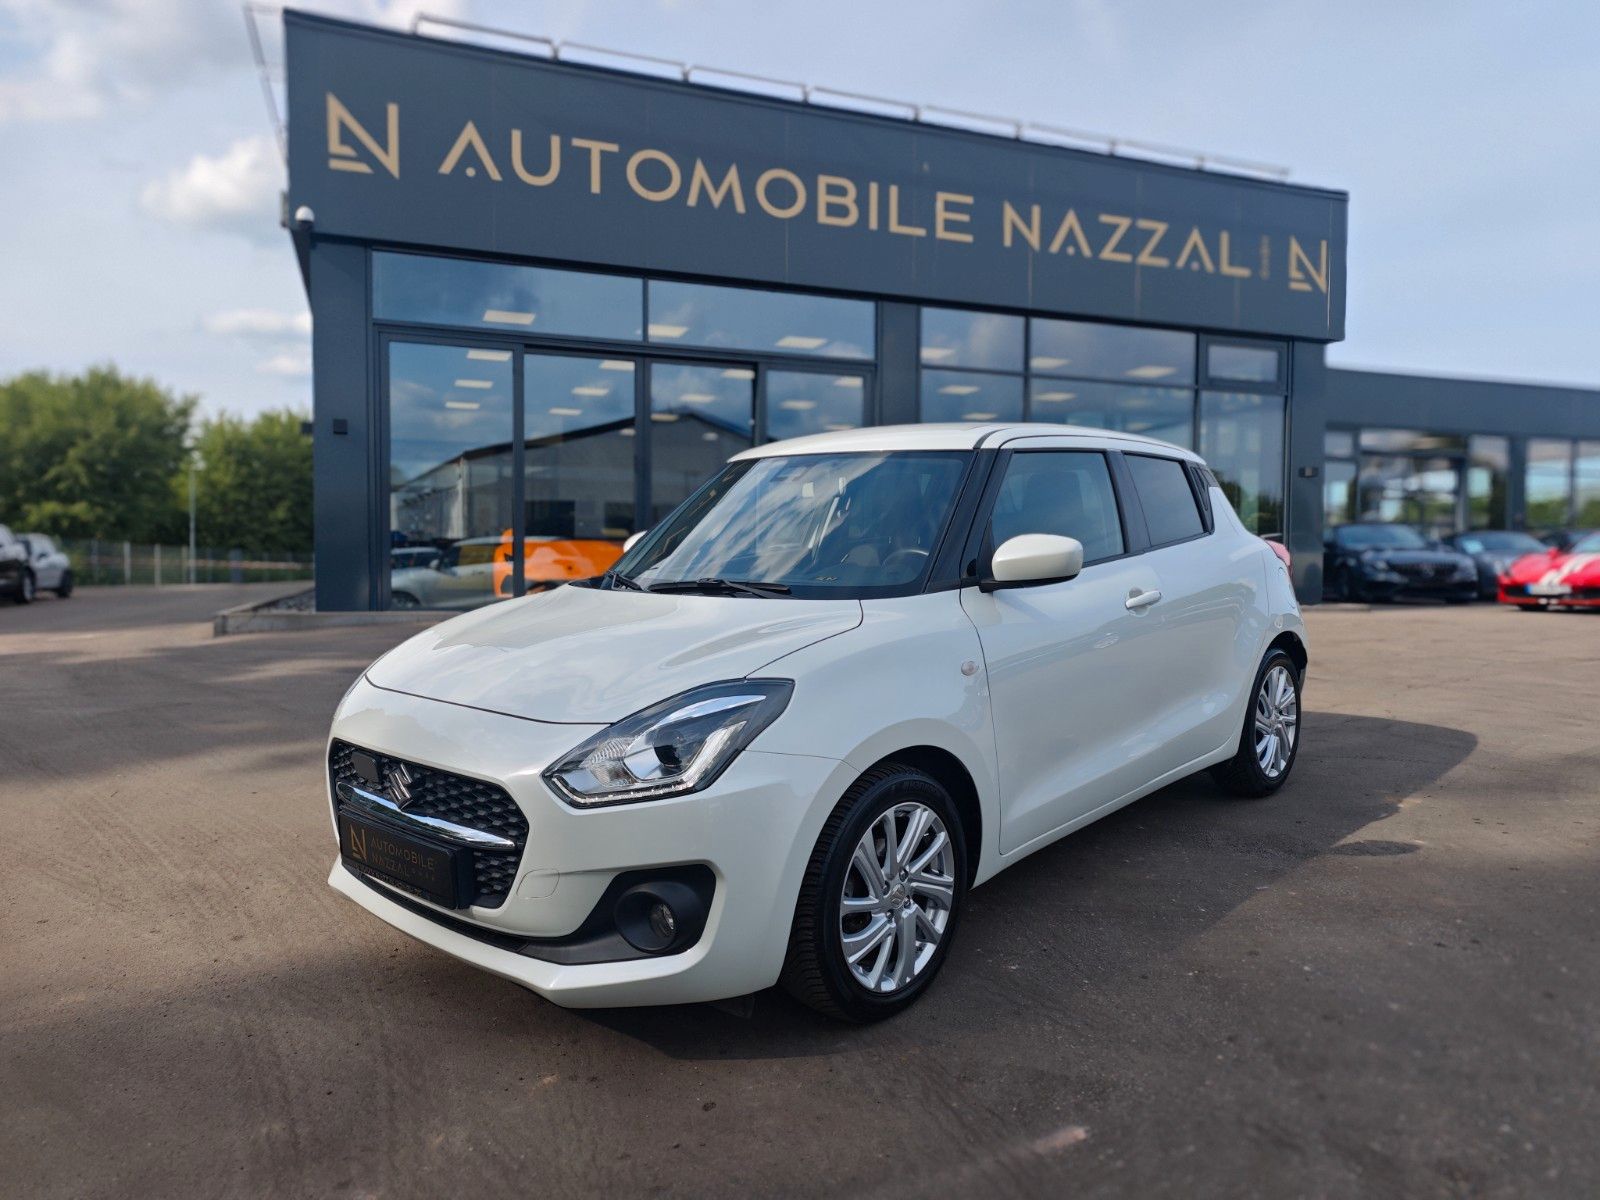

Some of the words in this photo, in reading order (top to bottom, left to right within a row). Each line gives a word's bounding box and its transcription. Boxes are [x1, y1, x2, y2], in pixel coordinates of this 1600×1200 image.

[437, 120, 975, 243] AUTOMOBILE
[1003, 200, 1252, 279] NAZZAL
[371, 837, 434, 869] AUTOMOBILE
